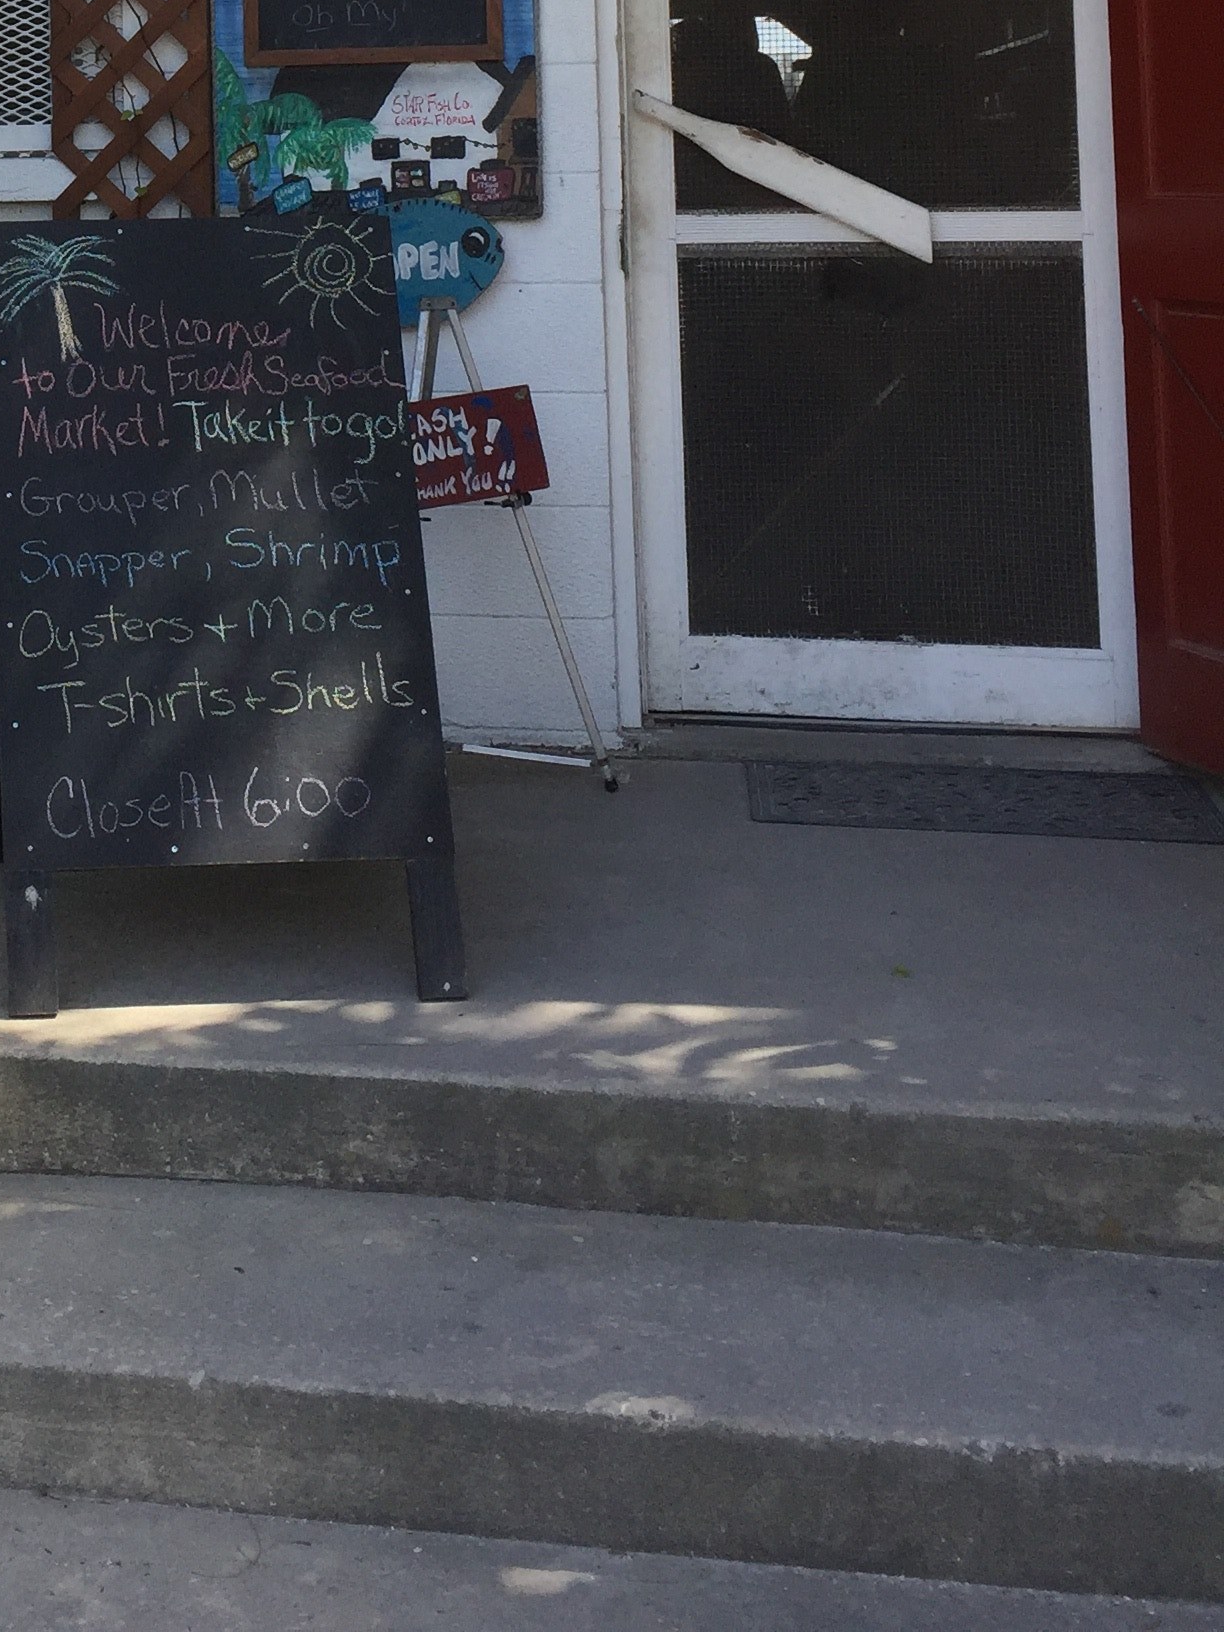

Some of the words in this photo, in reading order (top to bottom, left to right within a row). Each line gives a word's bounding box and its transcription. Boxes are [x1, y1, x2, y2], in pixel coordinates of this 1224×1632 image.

[393, 240, 461, 282] PEN
[94, 300, 291, 351] Welcome
[12, 357, 55, 399] to
[66, 357, 157, 398] Our
[167, 351, 262, 397] Fresh
[263, 352, 407, 396] Seafood
[17, 401, 171, 458] Market!
[410, 406, 468, 441] ASH
[209, 470, 378, 510] Mullet
[415, 476, 457, 500] HANK
[225, 527, 401, 586] Shrimp
[19, 604, 193, 668] Oysters
[247, 596, 382, 638] More
[269, 651, 414, 715] Shells
[47, 775, 171, 838] Close
[179, 770, 224, 830] At
[244, 767, 371, 828] 6:00
